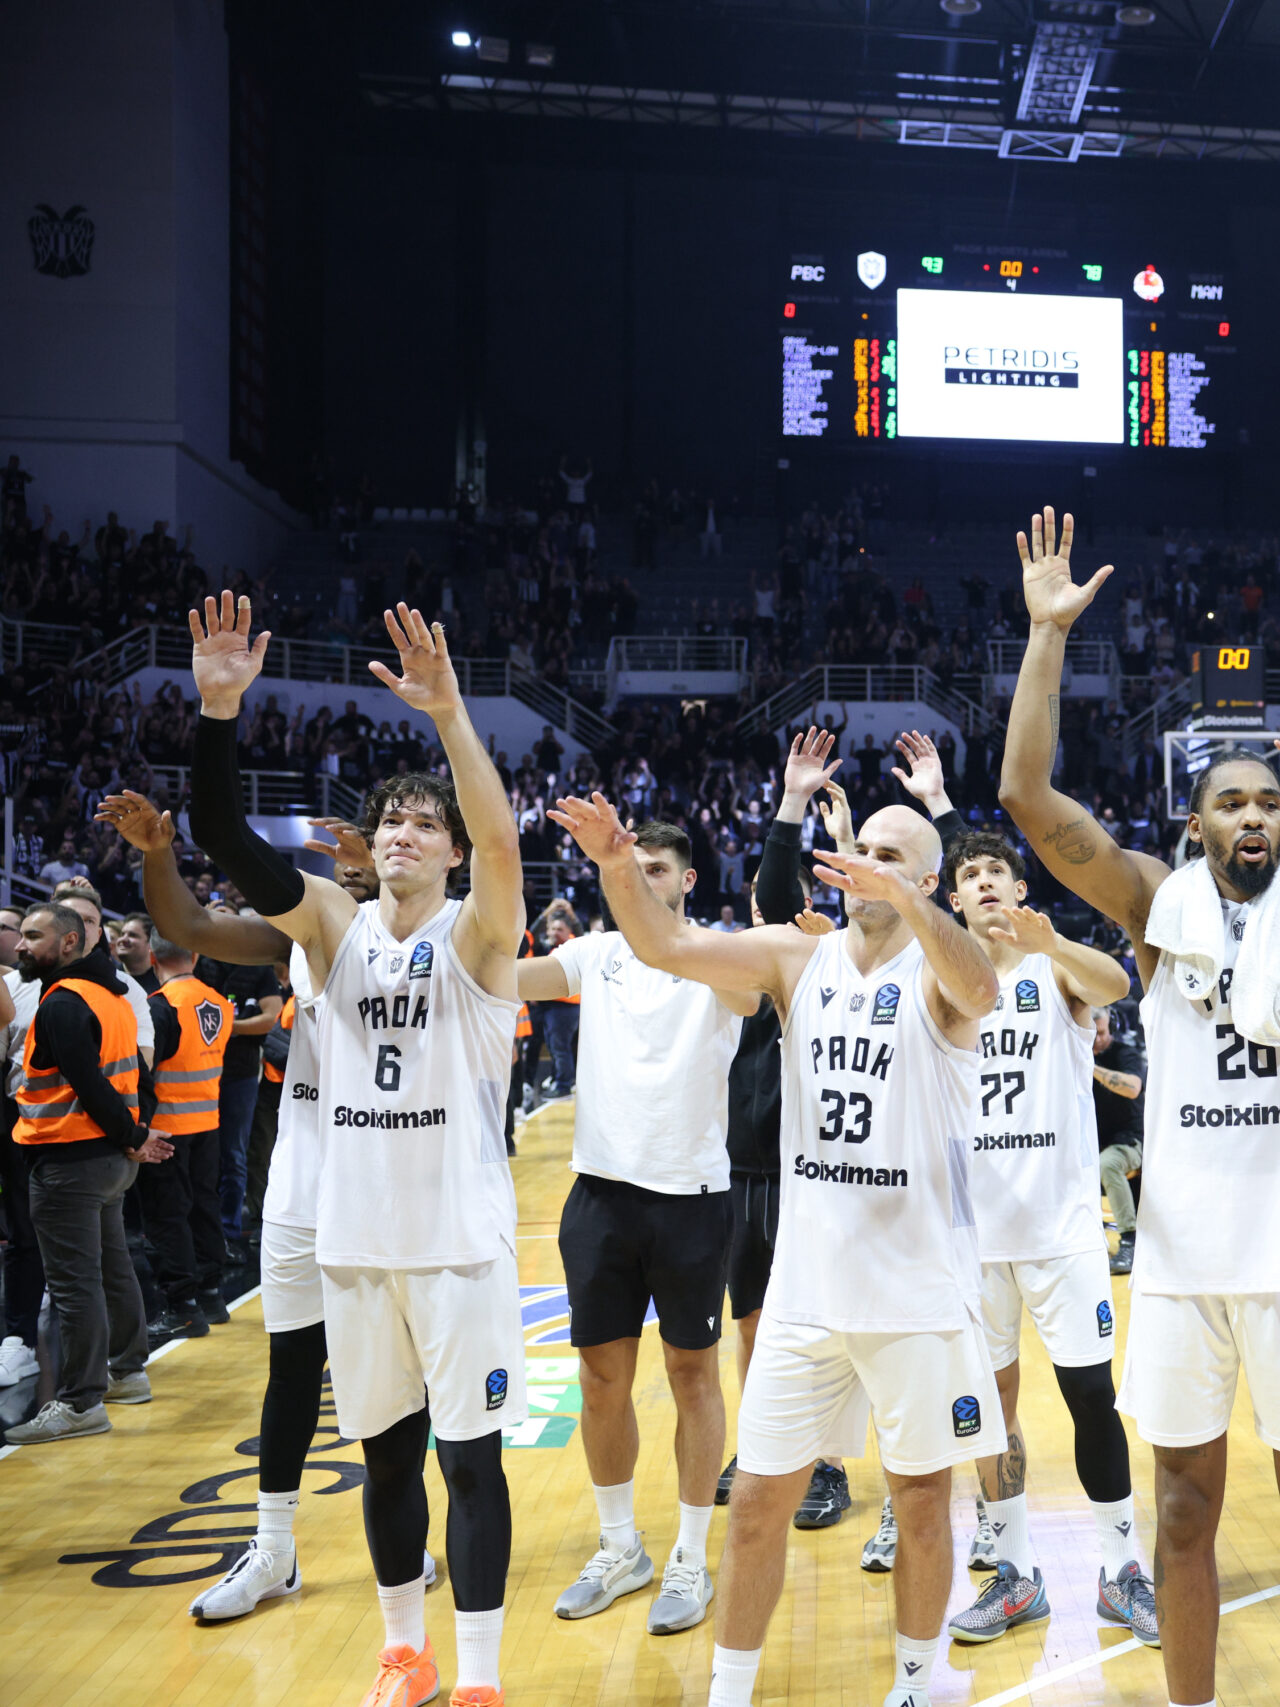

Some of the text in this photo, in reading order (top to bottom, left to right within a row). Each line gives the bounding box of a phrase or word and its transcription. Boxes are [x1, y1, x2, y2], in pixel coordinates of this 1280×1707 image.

[790, 265, 825, 282] PBC
[921, 256, 944, 274] 93
[999, 260, 1023, 277] 00
[1006, 278, 1017, 291] 4
[1190, 284, 1224, 300] MAN
[784, 302, 796, 318] 0
[1218, 322, 1230, 337] 0
[944, 346, 1079, 370] PETRIDIS
[958, 372, 1062, 388] LIGHTING
[357, 994, 429, 1031] PAOK
[980, 1029, 1039, 1060] AOK
[811, 1035, 895, 1081] PAOK
[374, 1044, 402, 1092] 6
[980, 1070, 1026, 1117] 77
[333, 1105, 446, 1130] Stoiximan
[819, 1088, 873, 1144] 33
[956, 1425, 980, 1435] EuroCup
[958, 1419, 977, 1429] BKT
